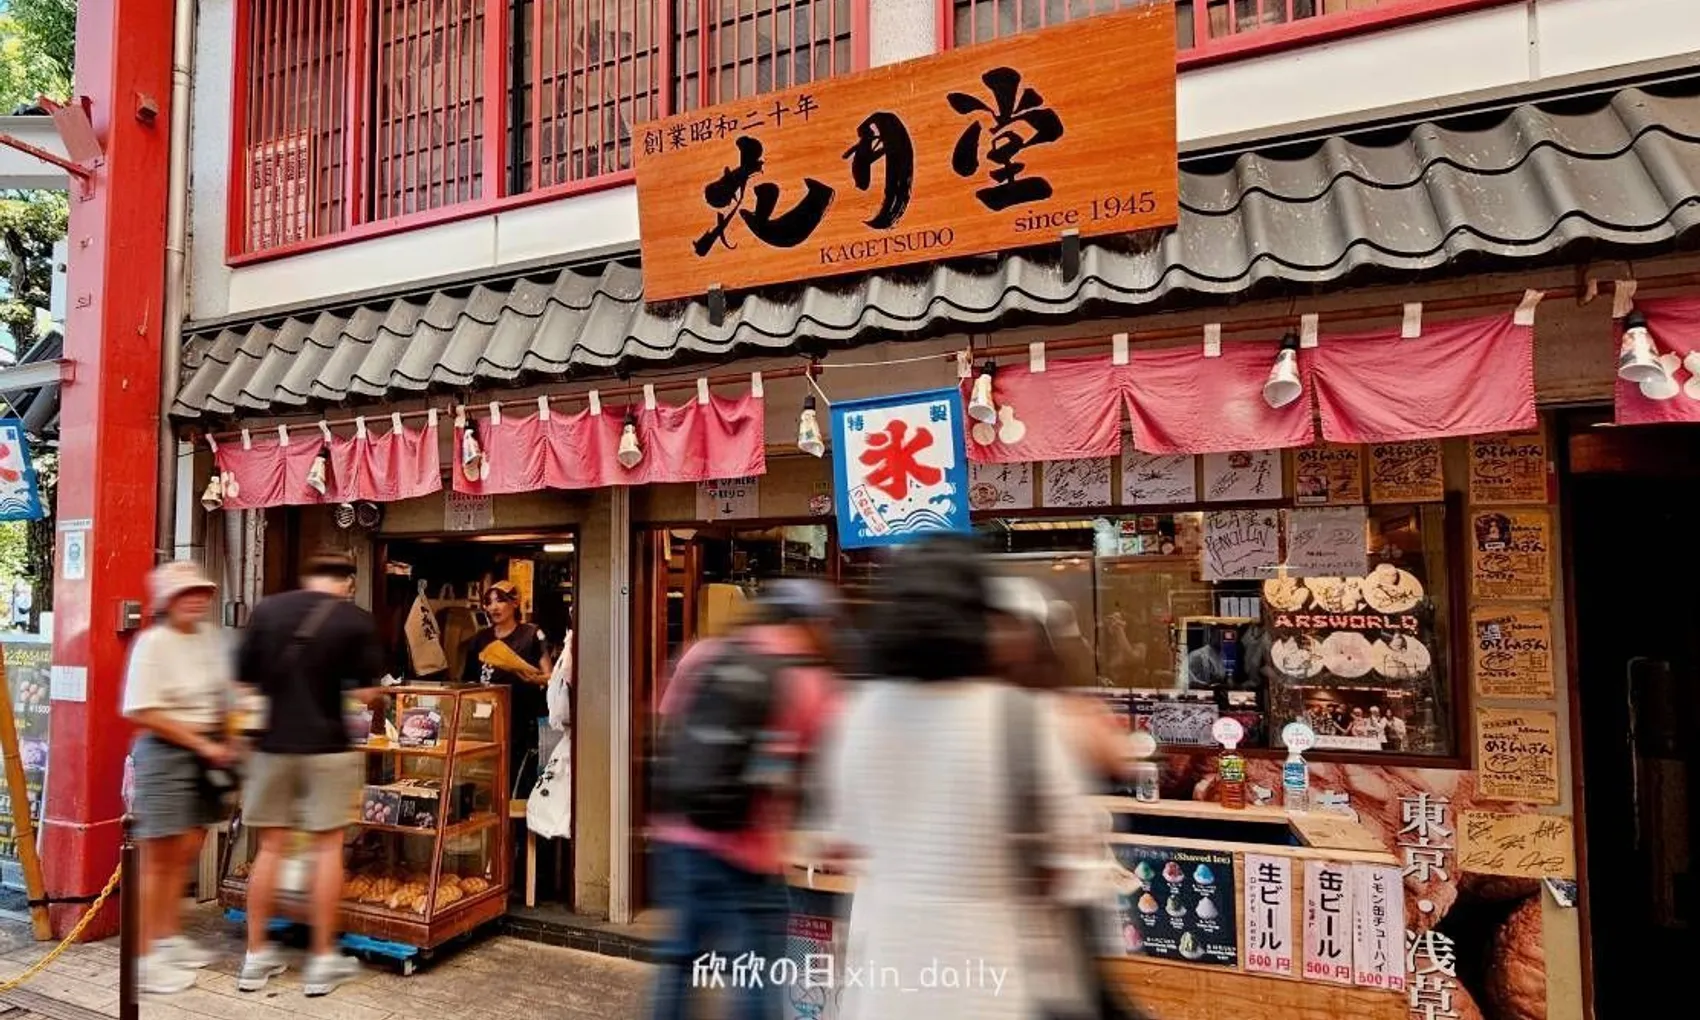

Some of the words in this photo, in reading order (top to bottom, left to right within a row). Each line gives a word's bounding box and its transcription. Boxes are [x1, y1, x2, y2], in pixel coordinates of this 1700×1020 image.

[643, 93, 819, 155] 創業昭和二十年
[693, 66, 1064, 257] 花月堂
[819, 227, 955, 265] KAGETSUDO
[1014, 205, 1080, 233] since
[1089, 191, 1157, 222] 1945
[858, 419, 942, 501] 氷
[1258, 863, 1282, 950] 生ビール
[1317, 870, 1344, 958] 缶ビール
[1397, 792, 1459, 1020] 東京・浅草
